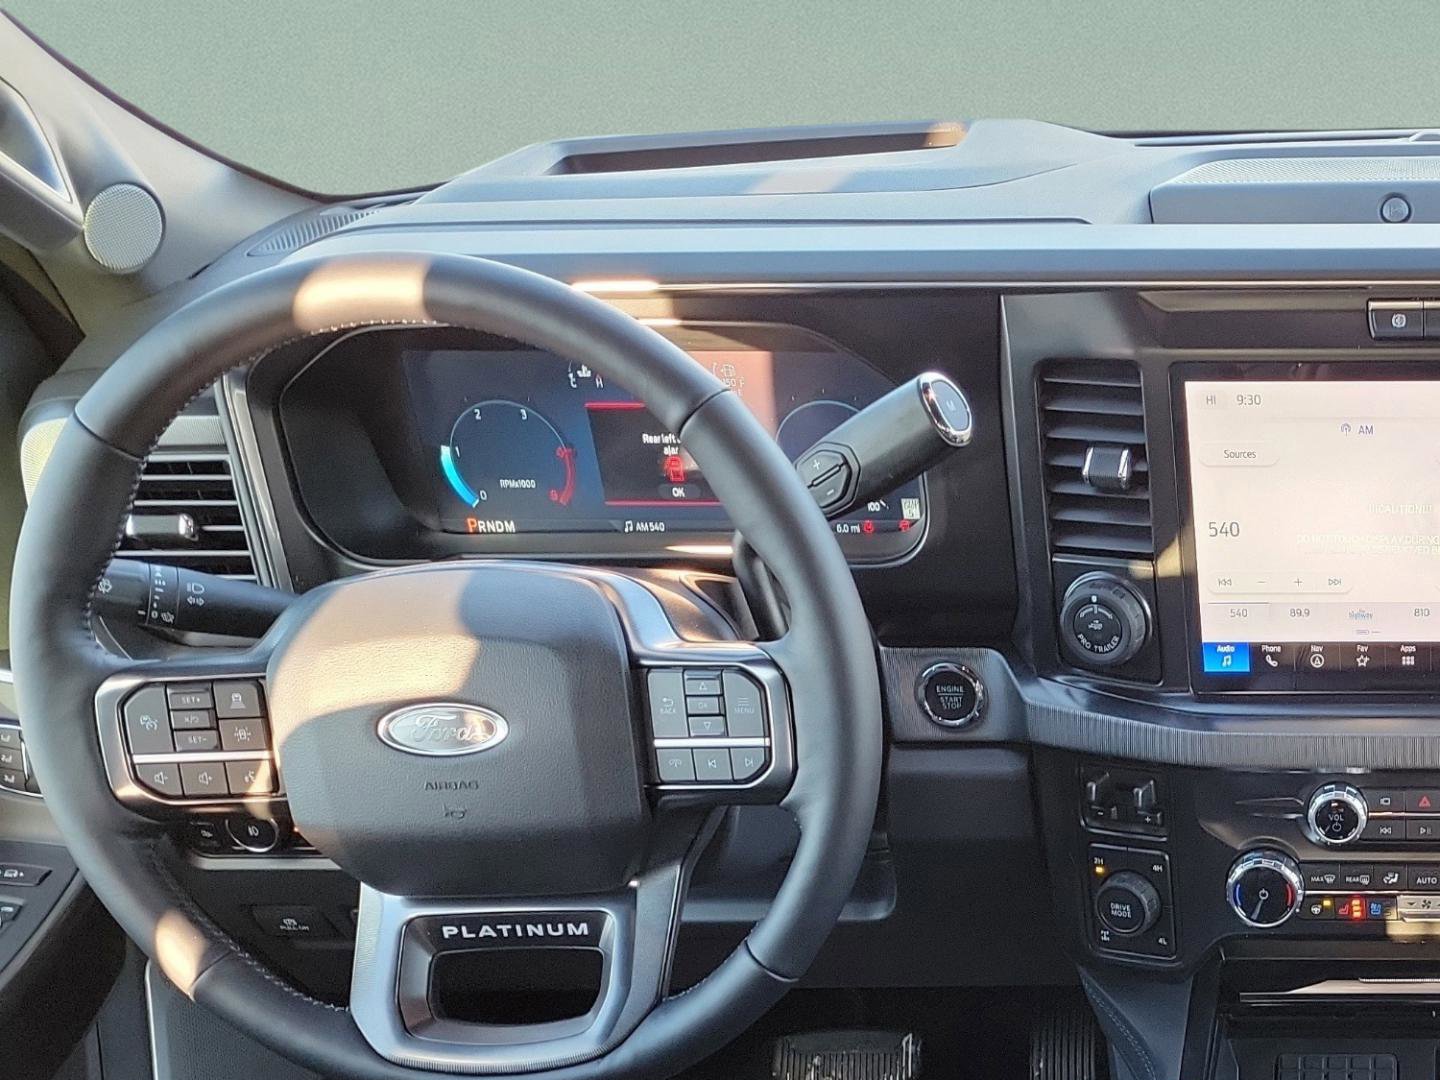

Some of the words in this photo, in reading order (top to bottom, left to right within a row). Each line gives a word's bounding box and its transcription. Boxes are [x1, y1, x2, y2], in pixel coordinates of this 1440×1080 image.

[1206, 395, 1217, 405] HI
[1236, 395, 1262, 406] 9:30
[474, 409, 482, 420] 2
[520, 409, 528, 420] 3
[1357, 424, 1374, 435] AM
[642, 433, 660, 444] Rear
[1223, 449, 1257, 459] Sources
[479, 490, 487, 501] 0
[672, 487, 685, 498] OK
[636, 523, 649, 532] AM
[649, 522, 665, 531] 540
[1208, 521, 1241, 538] 540
[1230, 608, 1248, 618] 540
[1289, 608, 1311, 618] 89.9
[1414, 608, 1430, 617] 810
[1078, 633, 1092, 650] PRO
[1094, 635, 1120, 653] TRAILER
[1216, 644, 1235, 653] Audio
[1261, 644, 1282, 653] Phone
[1310, 644, 1323, 653] Nav
[1356, 644, 1369, 653] Fav
[1400, 644, 1416, 654] Apps
[936, 685, 964, 693] ENGINE
[1328, 813, 1345, 822] VOL
[1416, 877, 1438, 885] AUTO
[1110, 902, 1131, 912] DRIVE
[1111, 910, 1132, 918] MODE
[441, 922, 589, 939] PLATINUM
